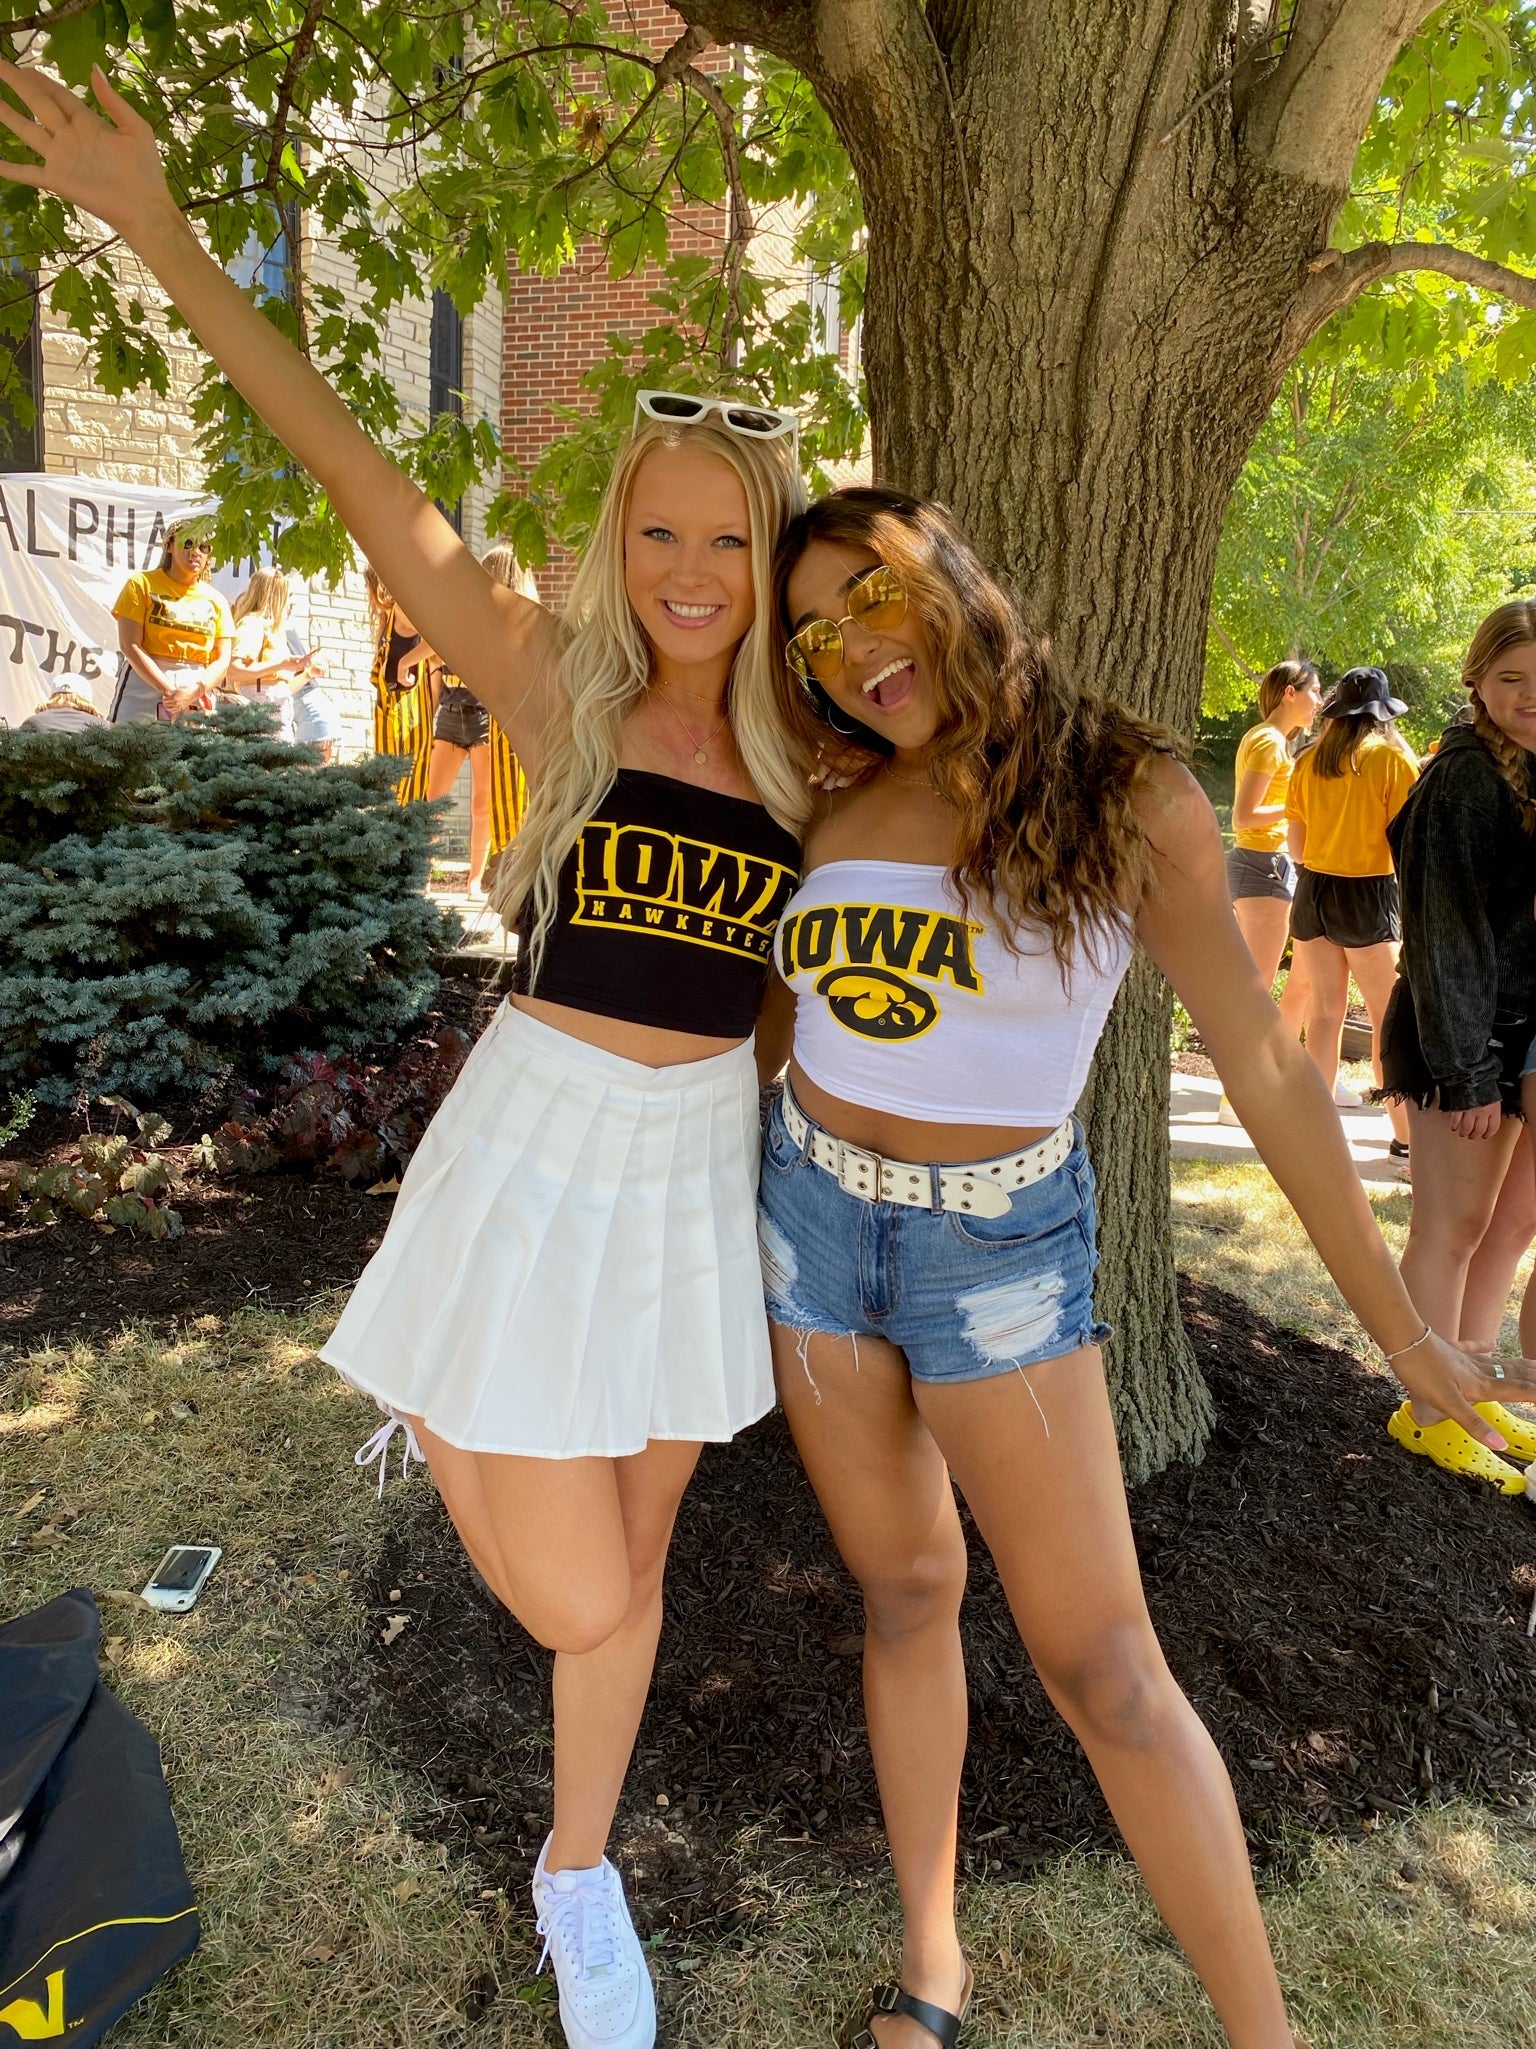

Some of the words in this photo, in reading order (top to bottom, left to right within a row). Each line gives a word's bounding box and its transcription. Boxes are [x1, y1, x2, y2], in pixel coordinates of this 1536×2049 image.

[592, 900, 769, 952] HAWKEYES
[780, 902, 985, 997] IOWA
[68, 2017, 85, 2029] TM
